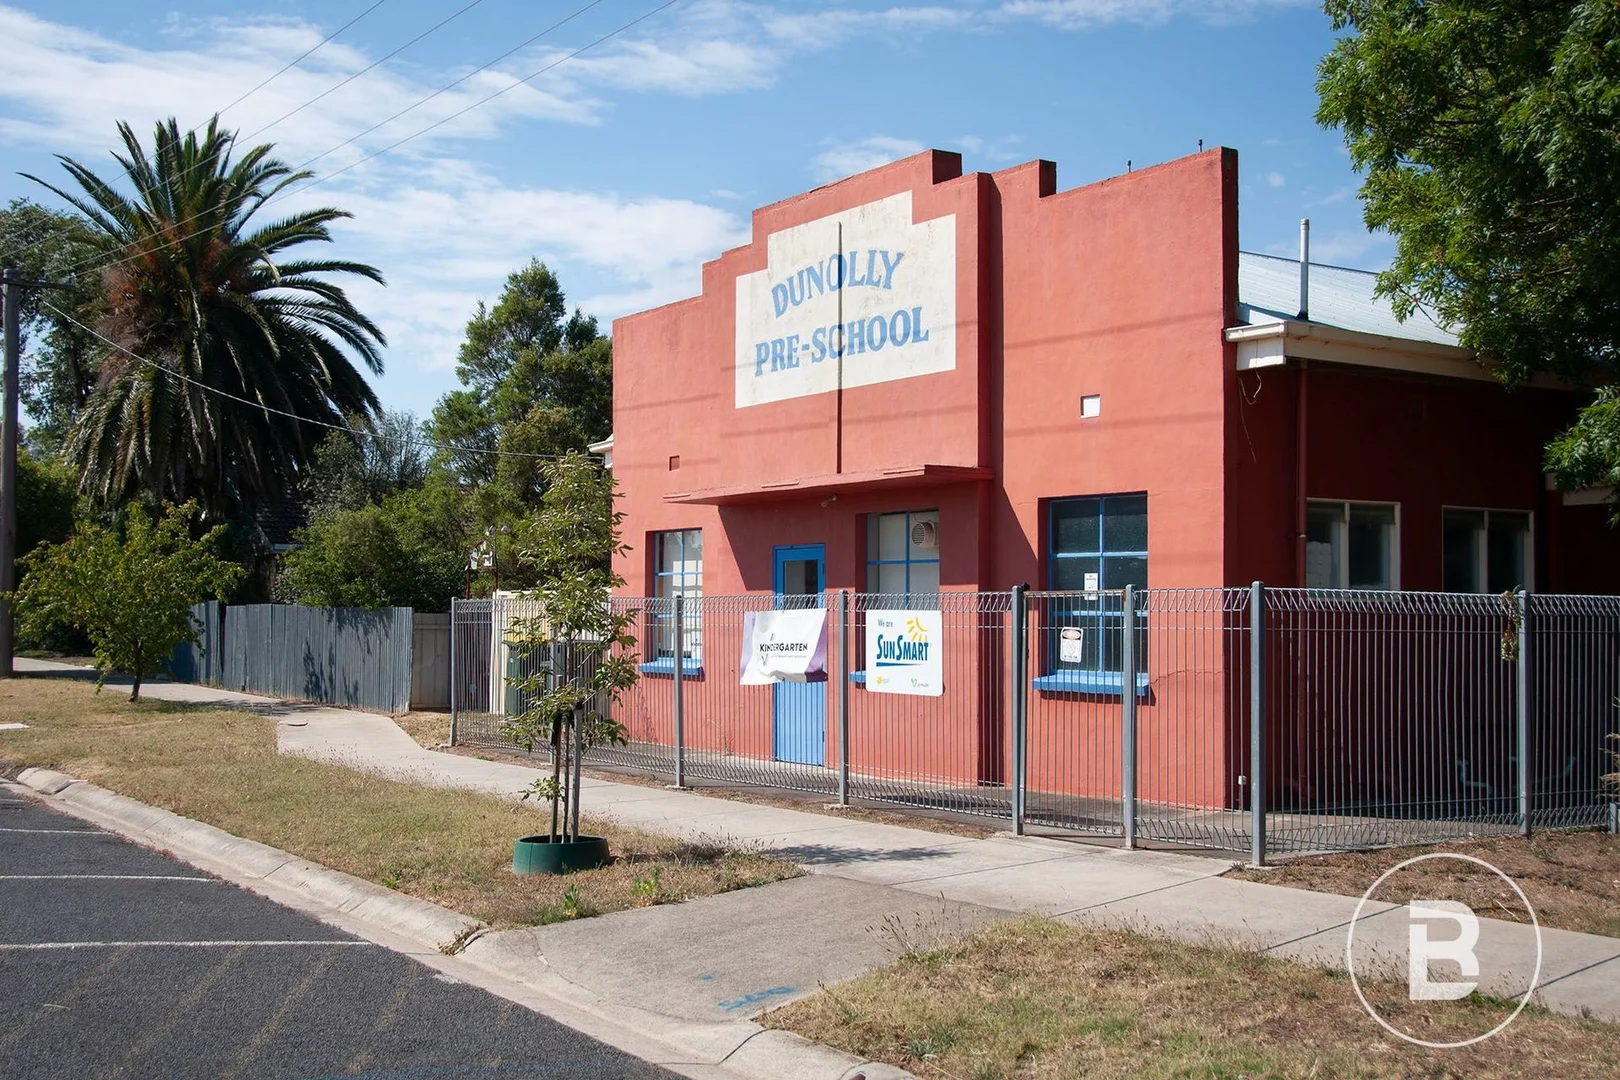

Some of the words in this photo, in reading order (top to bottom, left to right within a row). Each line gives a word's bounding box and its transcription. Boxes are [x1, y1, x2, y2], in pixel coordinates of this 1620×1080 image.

[771, 249, 905, 318] DUNOLLY
[755, 306, 929, 377] PRE-SCHOOL
[877, 618, 885, 628] We
